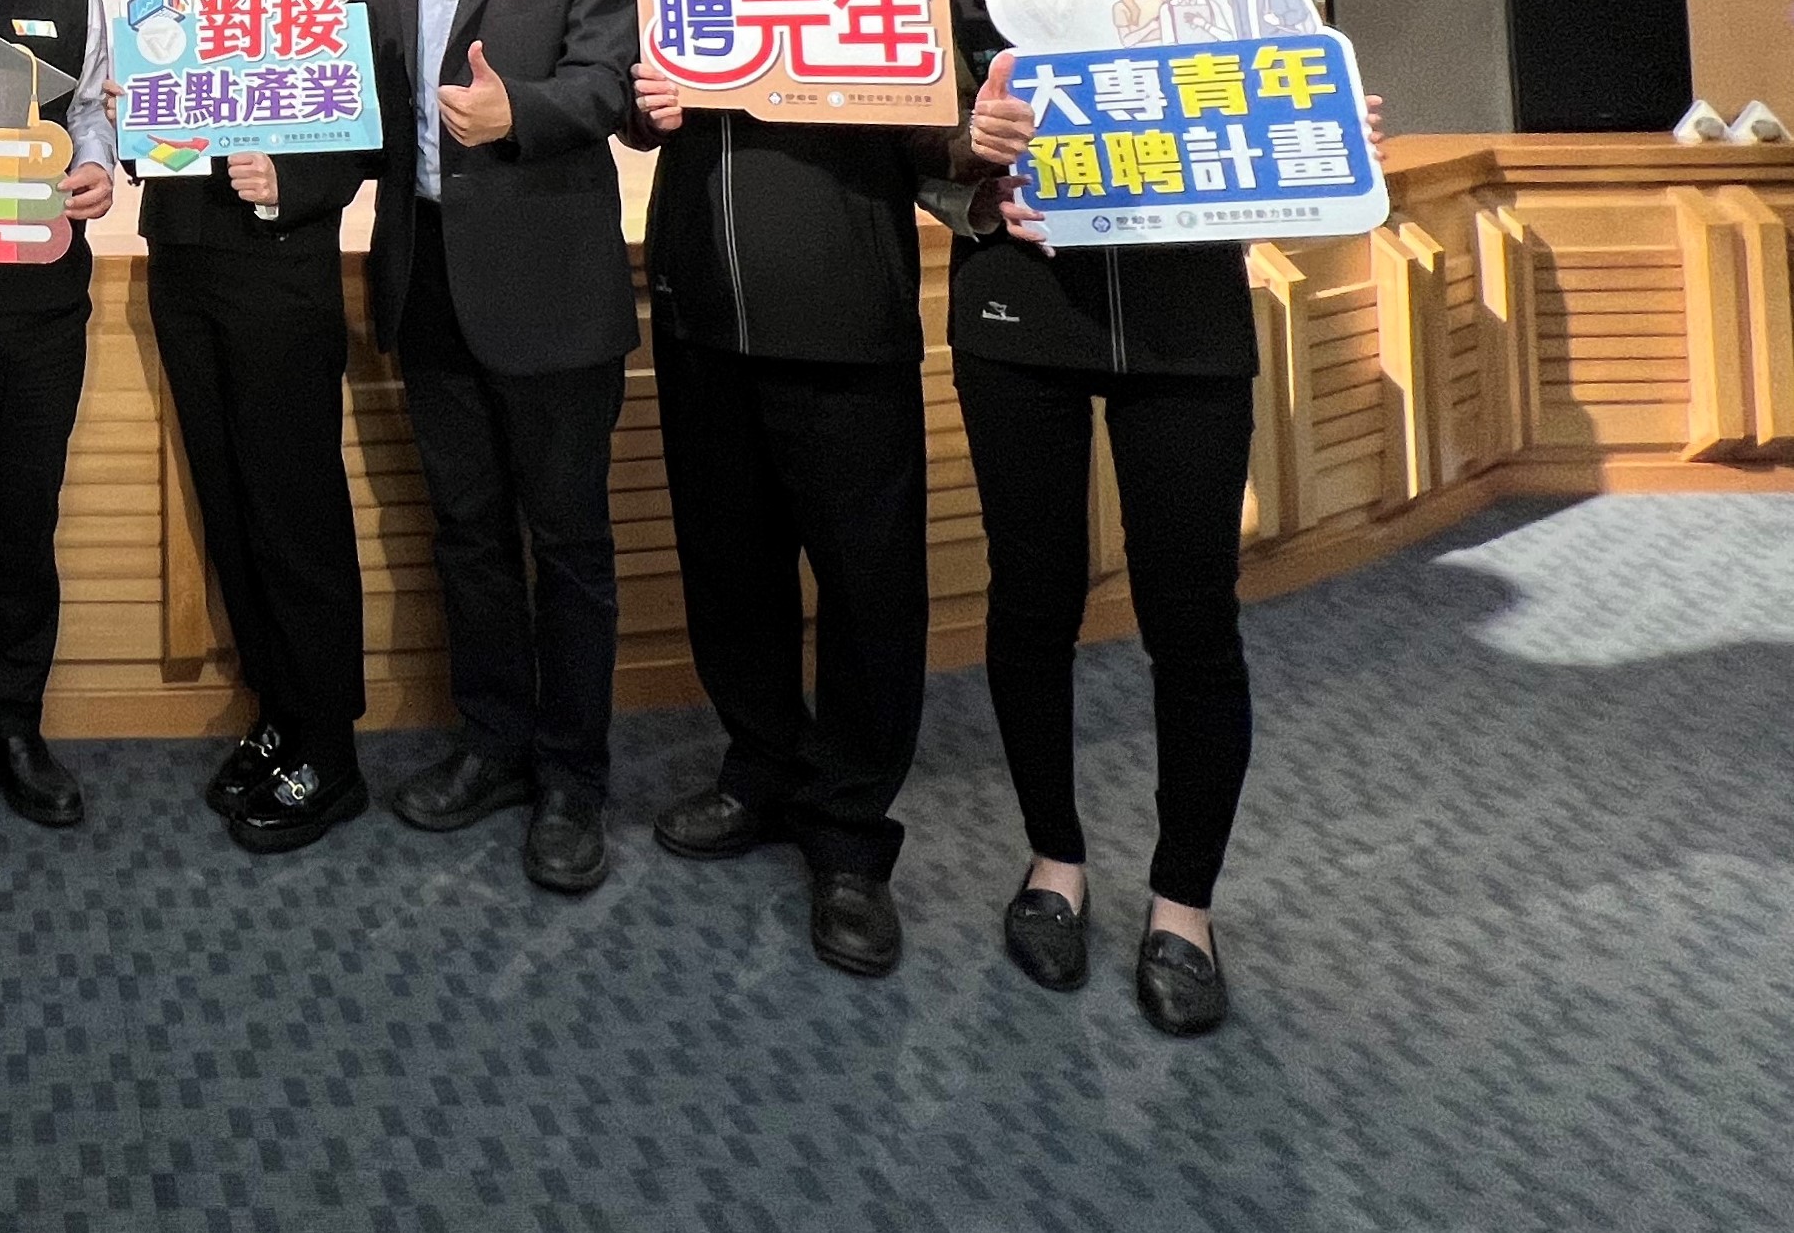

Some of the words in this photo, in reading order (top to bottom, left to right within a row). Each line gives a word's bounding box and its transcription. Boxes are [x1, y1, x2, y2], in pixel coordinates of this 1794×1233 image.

[124, 63, 360, 128] 重點產業
[1012, 44, 1337, 128] 大專青年
[1027, 119, 1356, 200] 預聘計畫
